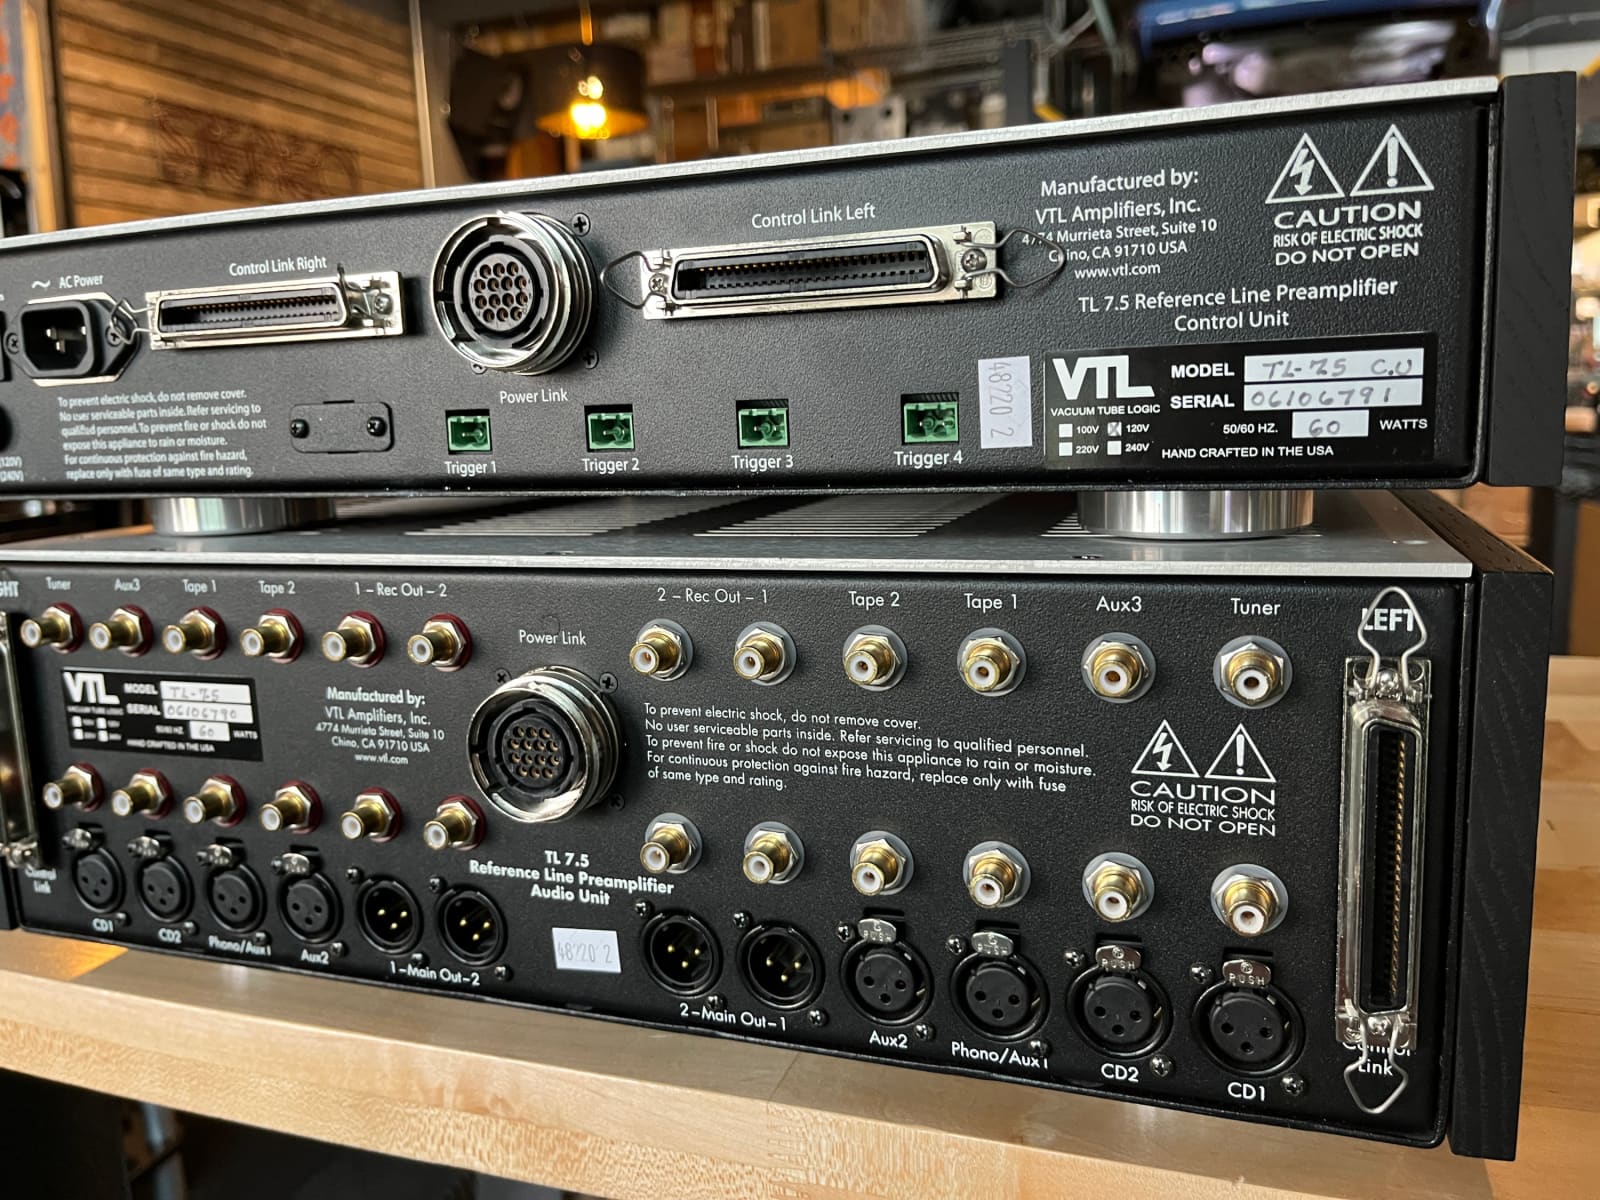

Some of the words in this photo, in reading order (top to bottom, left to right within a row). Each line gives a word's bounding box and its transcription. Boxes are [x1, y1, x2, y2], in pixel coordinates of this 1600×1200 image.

[1041, 169, 1165, 196] Manufactured
[1171, 168, 1198, 188] by:
[752, 209, 806, 228] Control
[811, 206, 842, 223] Link
[847, 203, 875, 220] Left
[1036, 208, 1067, 224] VTL
[1072, 200, 1167, 224] Amplifiers,
[1170, 198, 1200, 213] Inc.
[1273, 200, 1422, 231] CAUTION
[1057, 228, 1112, 242] Murrieta
[1116, 225, 1158, 238] Street,
[1162, 221, 1196, 234] Suite
[1201, 219, 1217, 231] 10
[1274, 233, 1298, 247] RISK
[1301, 232, 1317, 245] OF
[1321, 227, 1376, 244] ELECTRIC
[1379, 223, 1422, 240] SHOCK
[1049, 244, 1090, 263] Cino,
[1092, 246, 1111, 259] CA
[1115, 243, 1155, 257] 91710
[1159, 240, 1187, 254] USA
[1276, 251, 1306, 265] DO
[1313, 247, 1356, 262] NOT
[1361, 242, 1418, 259] OPEN
[229, 260, 269, 276] Control
[272, 258, 295, 272] Link
[297, 256, 327, 272] Right
[1075, 263, 1160, 278] www.vtl.com
[60, 276, 72, 288] AC
[74, 275, 103, 286] Power
[1079, 297, 1099, 312] TL
[1104, 295, 1129, 311] 7.5
[1136, 292, 1225, 309] Reference
[1232, 287, 1270, 303] Line
[1277, 278, 1398, 301] Preamplifier
[1175, 312, 1242, 331] Control
[1250, 310, 1288, 327] Unit
[1052, 355, 1155, 400] VTL
[1172, 363, 1234, 378] MODEL
[187, 391, 219, 400] remove
[221, 390, 246, 399] cover.
[500, 391, 538, 403] Power
[542, 388, 568, 401] Link
[1171, 394, 1234, 409] SERIAL
[1051, 407, 1094, 416] VACUUM
[1097, 406, 1124, 415] TUBE
[1128, 405, 1160, 414] LOGIC
[991, 427, 1014, 438] 2
[1127, 424, 1149, 432] 120V
[1223, 424, 1254, 434] 50/60
[1258, 423, 1278, 432] HZ.
[1309, 418, 1340, 437] 60
[1380, 419, 1427, 429] WATTS
[1076, 446, 1099, 454] 220V
[1126, 443, 1149, 451] 240V
[1162, 449, 1196, 458] HAND
[1200, 448, 1258, 457] CRAFTED
[1262, 447, 1274, 456] IN
[1278, 446, 1303, 456] THE
[1307, 446, 1333, 455] USA
[581, 458, 628, 474] Trigger
[632, 458, 639, 470] 2
[731, 455, 781, 473] Trigger
[786, 455, 793, 467] 3
[894, 451, 951, 469] Trigger
[953, 450, 963, 464] 4
[444, 461, 487, 476] Trigger
[491, 461, 496, 472] 1
[46, 577, 70, 590] Tuner
[115, 578, 140, 591] Aux3
[183, 579, 207, 595] Tape
[212, 580, 216, 592] 1
[259, 580, 284, 597] Tape
[288, 581, 295, 594] 2
[377, 582, 397, 596] Rec
[401, 583, 423, 596] Out
[439, 584, 447, 596] 2
[658, 588, 665, 601] 2
[686, 588, 709, 602] Rec
[715, 589, 740, 603] Out
[762, 589, 766, 603] 1
[849, 591, 884, 610] Tape
[891, 592, 899, 606] 2
[964, 593, 1002, 613] Tape
[1012, 594, 1016, 609] 1
[1096, 596, 1141, 612] Aux3
[1231, 598, 1280, 615] Tuner
[520, 630, 558, 644] Power
[562, 631, 586, 645] Link
[63, 672, 120, 704] VTL
[327, 687, 403, 703] Manufactured
[407, 690, 425, 708] by:
[644, 703, 656, 714] To
[661, 707, 701, 717] prevent
[705, 706, 745, 719] electric
[751, 708, 786, 723] shock,
[792, 710, 806, 722] do
[812, 714, 829, 723] not
[835, 716, 878, 726] remove
[884, 719, 920, 729] cover.
[646, 719, 663, 731] No
[667, 724, 689, 732] user
[694, 723, 758, 738] serviceable
[763, 728, 791, 740] parts
[797, 728, 834, 741] inside.
[841, 730, 871, 743] Refer
[876, 735, 931, 752] servicing
[938, 738, 949, 748] to
[954, 738, 1011, 752] qualified
[1018, 744, 1088, 757] personnel.
[1130, 780, 1276, 806] CAUTION
[1132, 799, 1154, 812] RISK
[1158, 801, 1173, 813] OF
[1178, 801, 1230, 819] ELECTRIC
[1232, 806, 1275, 820] SHOCK
[1131, 814, 1161, 827] DO
[1168, 817, 1212, 831] NOT
[1219, 819, 1275, 836] OPEN
[545, 851, 560, 864] TL
[565, 853, 589, 867] 7.5
[470, 860, 539, 879] Reference
[545, 868, 574, 883] Line
[579, 870, 676, 896] Preamplifier
[531, 884, 574, 901] Audio
[579, 889, 609, 904] Unit
[93, 918, 113, 931] CD1
[159, 928, 181, 943] CD2
[301, 948, 329, 965] Aux2
[870, 1031, 907, 1048] Aux2
[1101, 1063, 1138, 1082] CD2
[1359, 1057, 1393, 1076] Link
[1228, 1082, 1264, 1101] CD1
